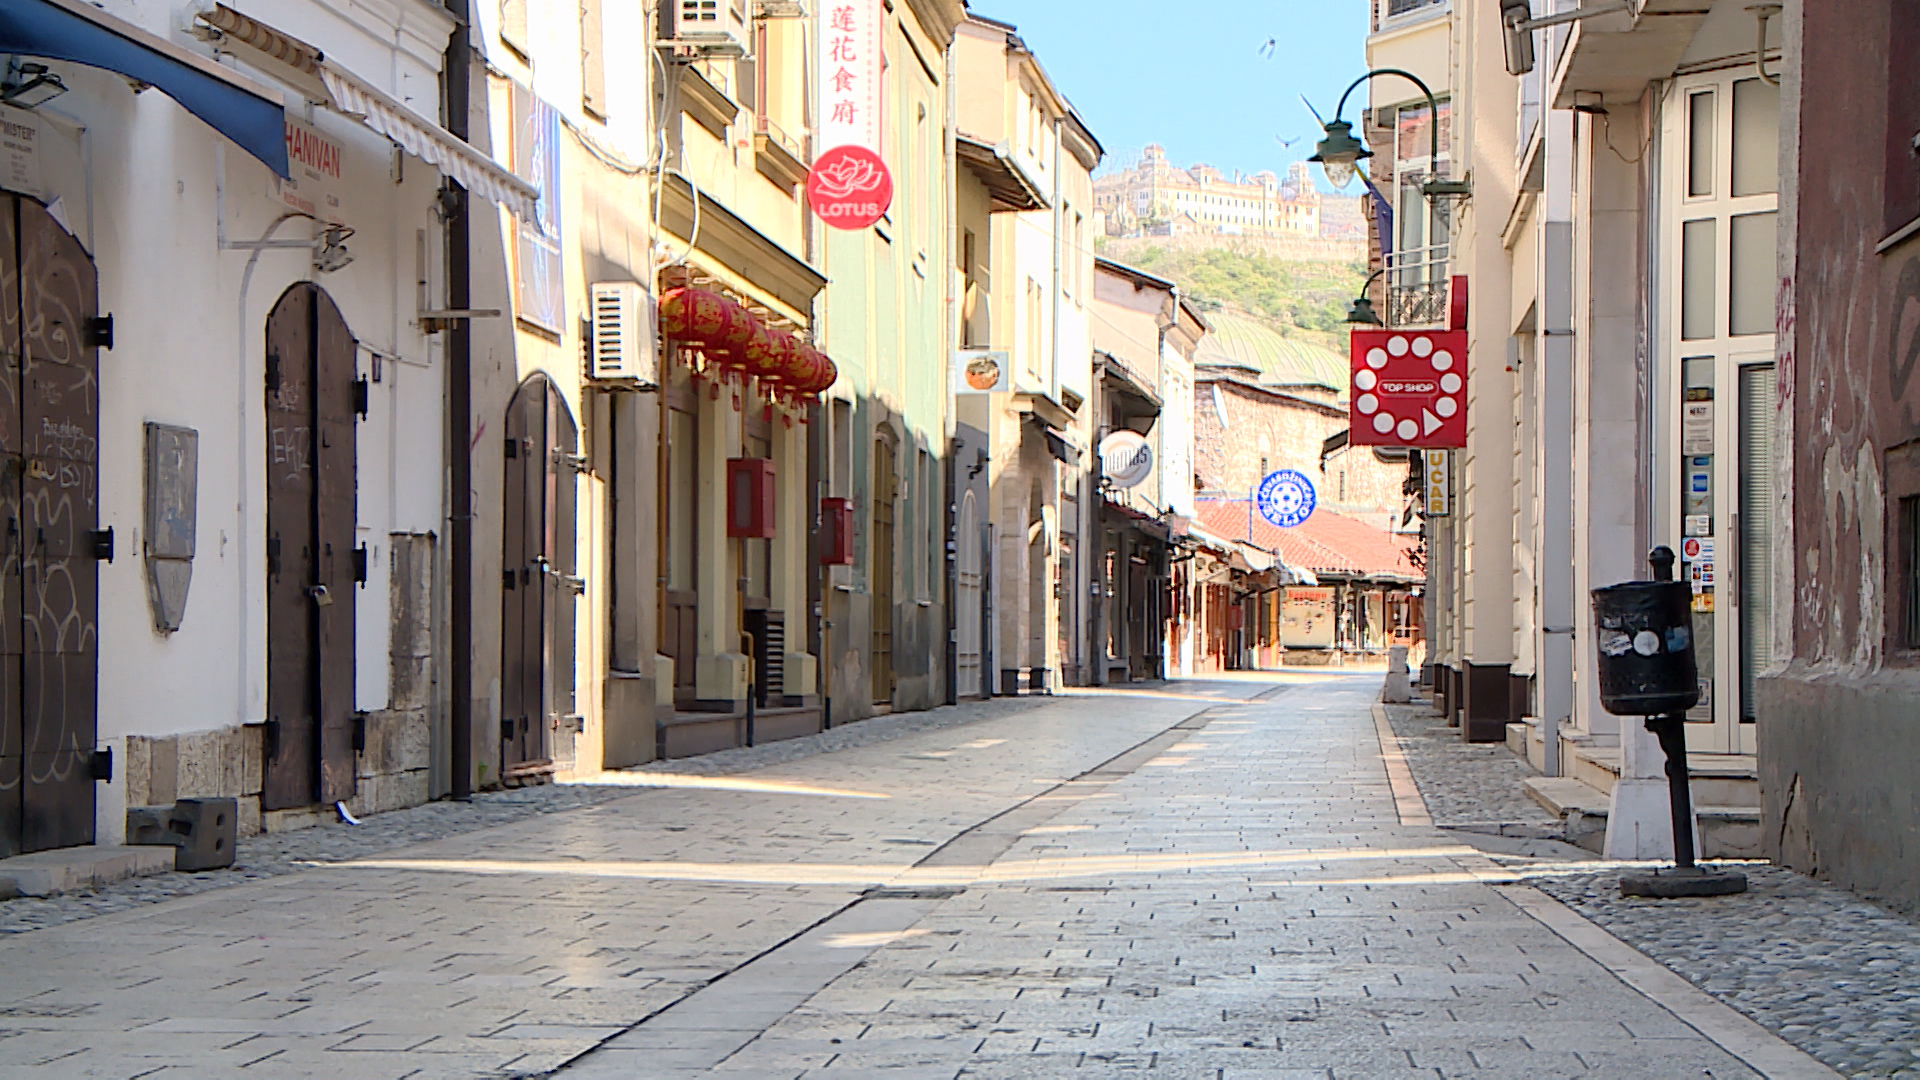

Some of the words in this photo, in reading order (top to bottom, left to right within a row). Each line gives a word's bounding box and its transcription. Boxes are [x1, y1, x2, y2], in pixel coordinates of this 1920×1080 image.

[819, 203, 879, 216] LOTUS
[1382, 382, 1404, 393] TOP
[1404, 382, 1435, 393] SHOP
